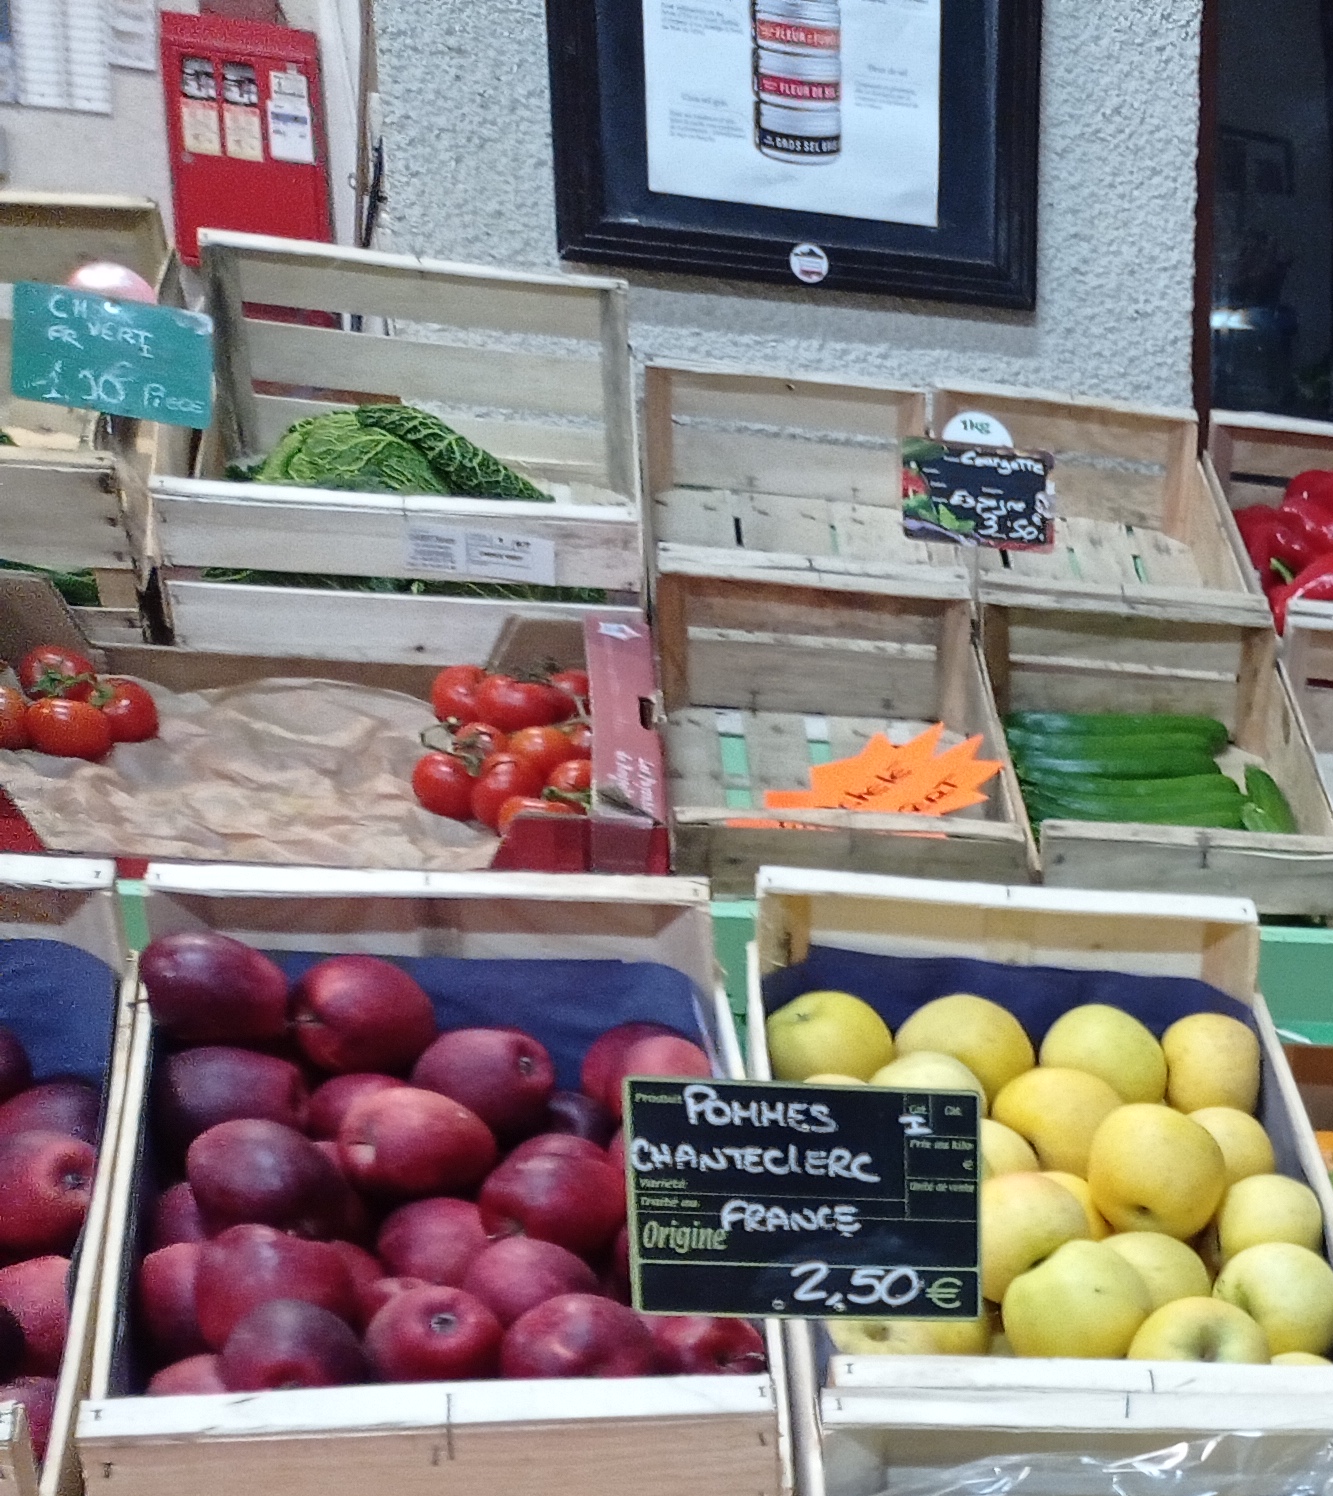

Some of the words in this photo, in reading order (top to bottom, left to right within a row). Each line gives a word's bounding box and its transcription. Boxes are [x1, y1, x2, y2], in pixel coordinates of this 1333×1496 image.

[779, 82, 810, 98] FLEUR
[803, 139, 820, 153] SEL
[960, 419, 993, 435] 1kg
[683, 1084, 840, 1134] POMMES
[630, 1136, 882, 1183] CHANTECLERC
[719, 1198, 862, 1236] FRANCE
[642, 1219, 729, 1254] Origine
